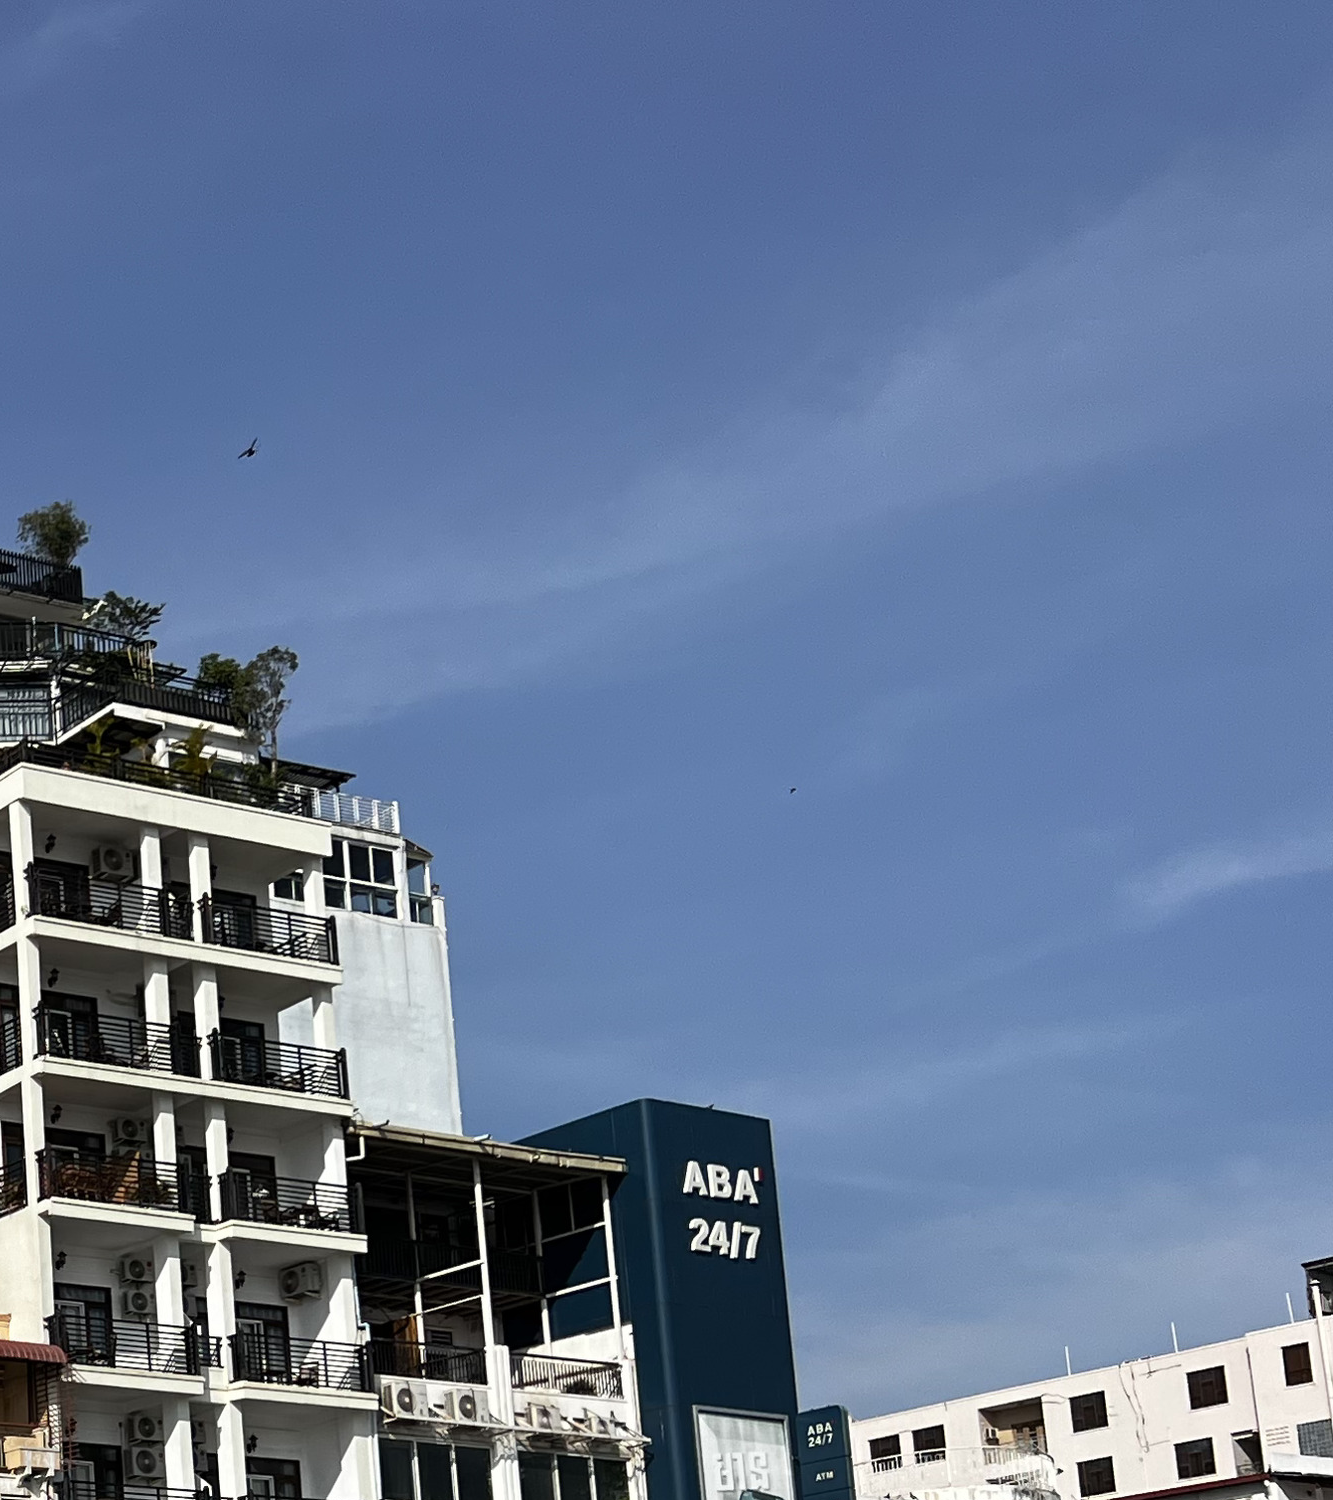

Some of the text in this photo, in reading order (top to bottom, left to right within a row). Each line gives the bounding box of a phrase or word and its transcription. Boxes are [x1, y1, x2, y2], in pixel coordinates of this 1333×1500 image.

[688, 1218, 761, 1259] 24/7
[807, 1422, 833, 1436] ABA
[808, 1433, 833, 1448] 24/7
[815, 1471, 834, 1481] ATM
